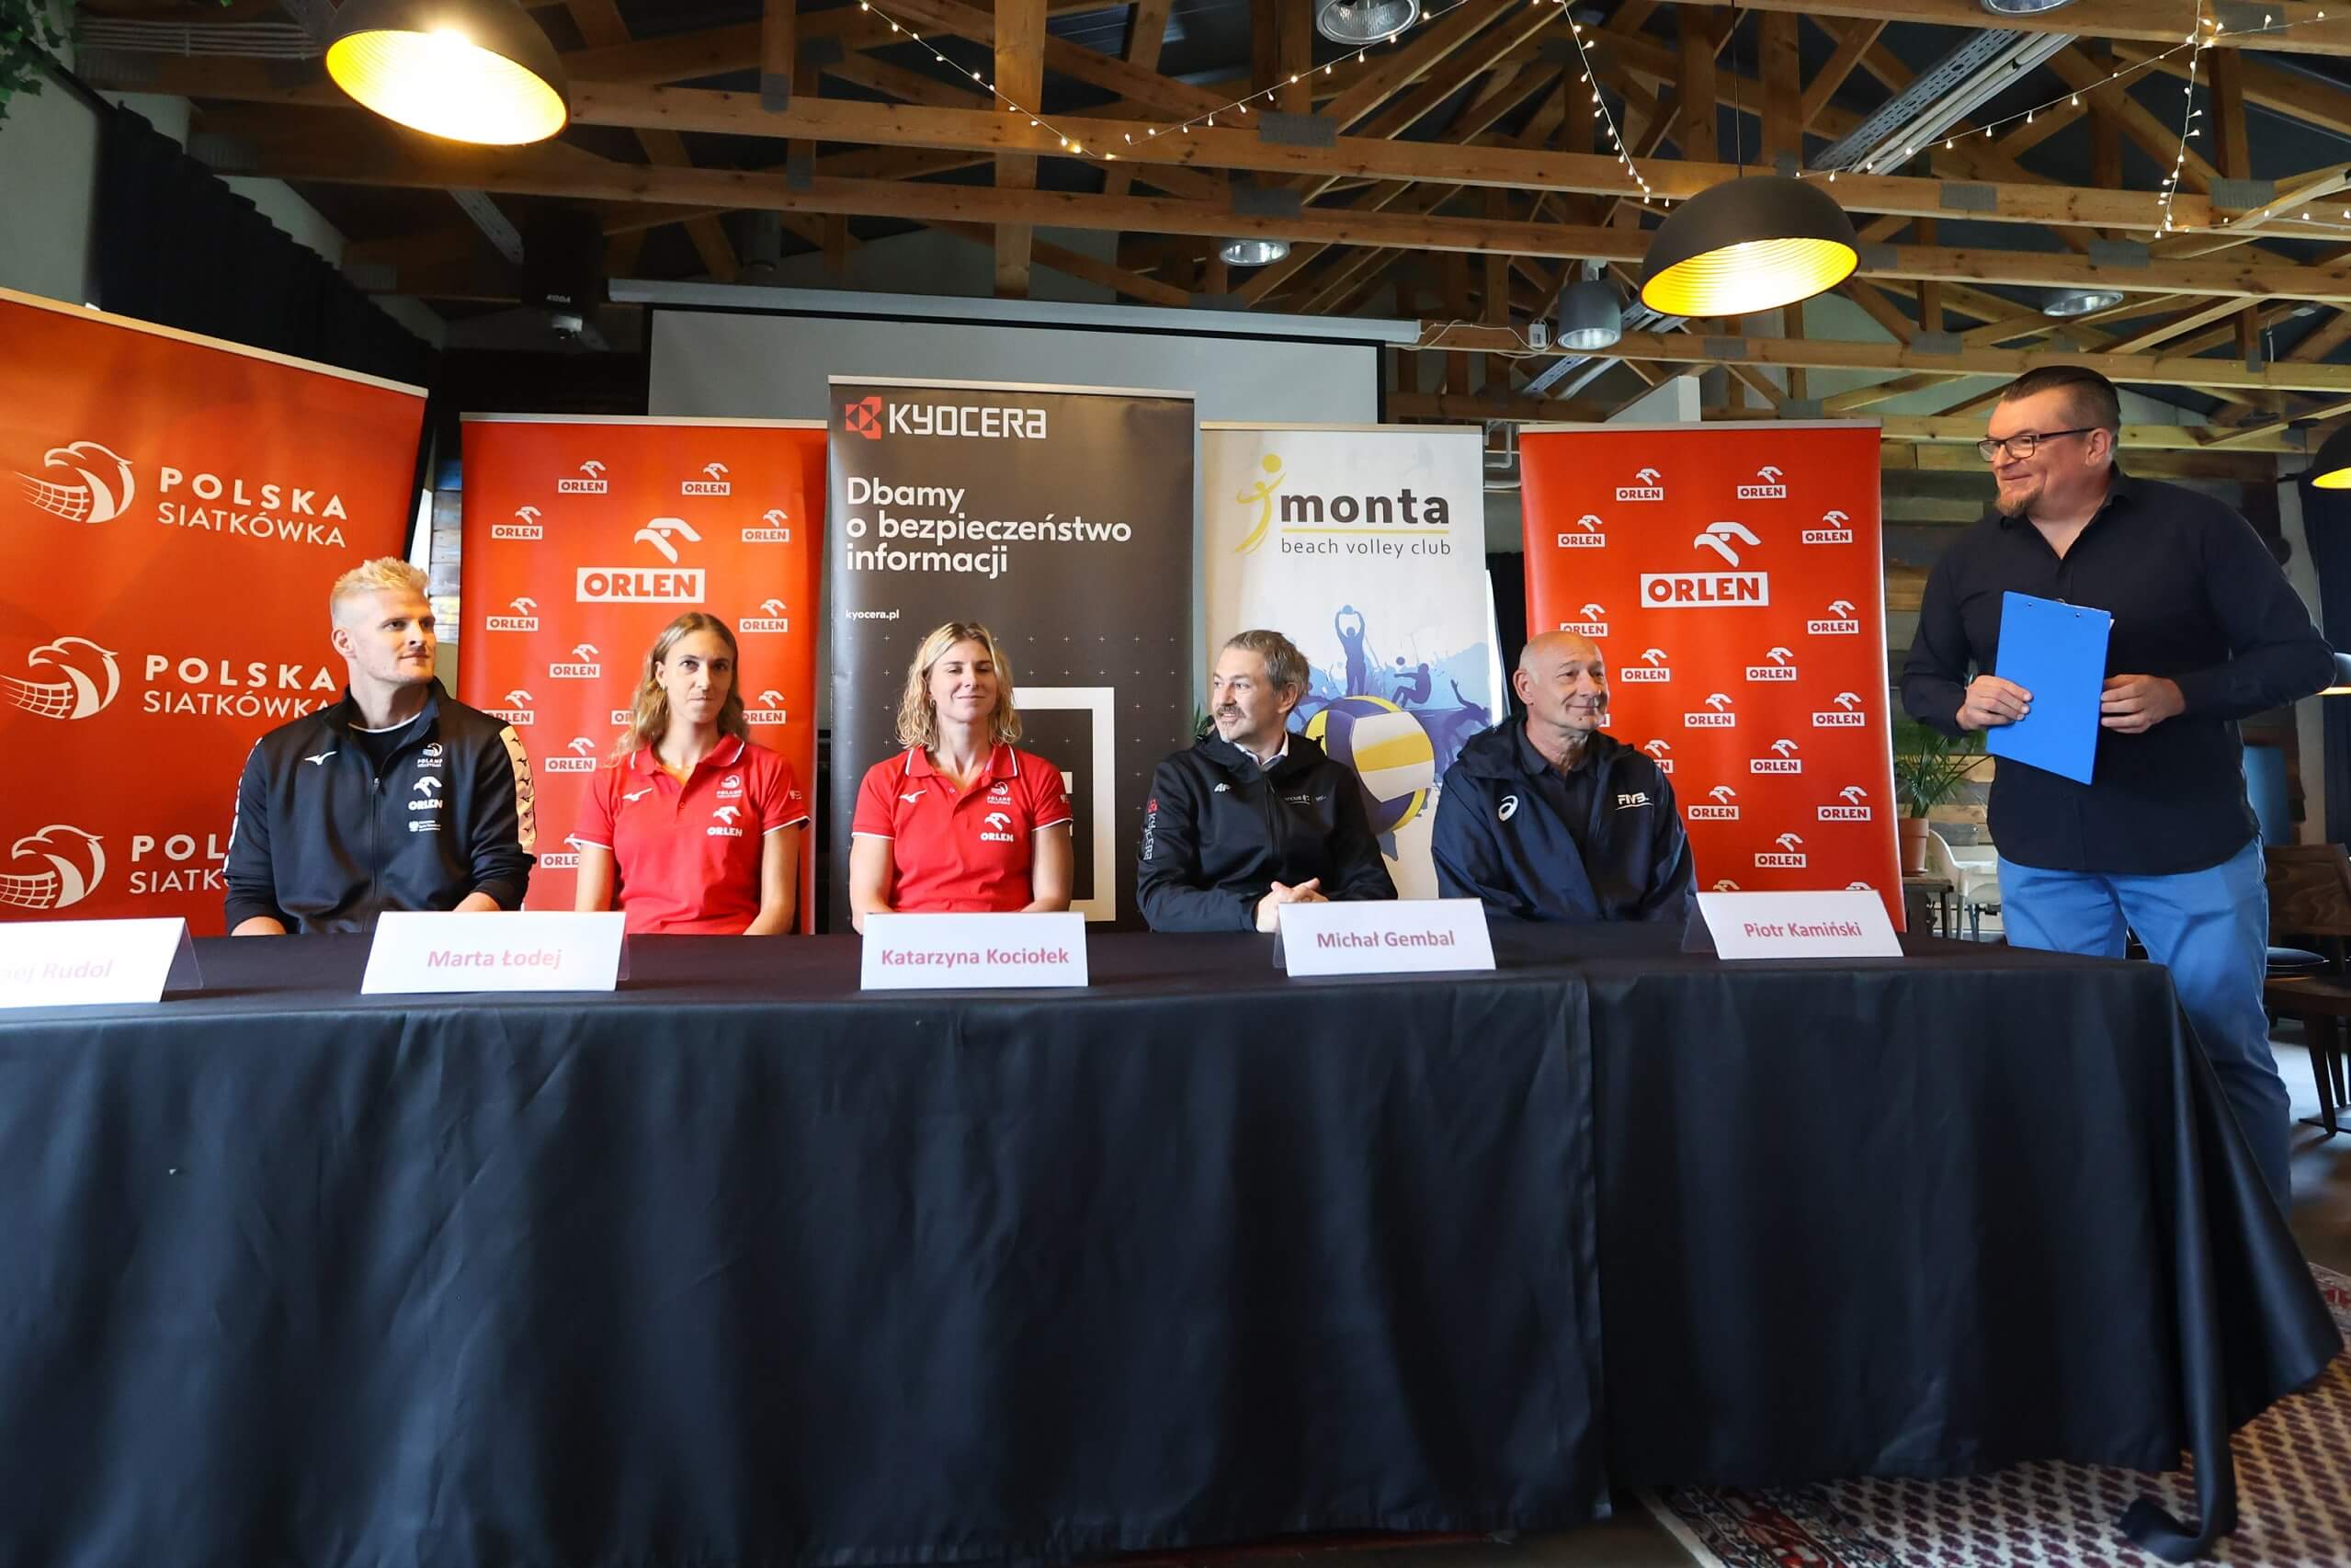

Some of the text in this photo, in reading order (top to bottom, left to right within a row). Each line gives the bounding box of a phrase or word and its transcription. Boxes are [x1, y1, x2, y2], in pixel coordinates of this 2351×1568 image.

[889, 403, 1047, 439] KYOCERA
[561, 482, 605, 492] ORLEN
[684, 483, 727, 494] ORLEN
[1740, 486, 1783, 498] ORLEN
[159, 466, 348, 521] POLSKA
[846, 477, 965, 514] Dbamy
[1618, 488, 1661, 499] ORLEN
[1280, 488, 1449, 525] monta
[157, 502, 346, 548] SIATKÓWKA
[846, 510, 1132, 547] o bezpieczeństwo
[494, 527, 539, 538] ORLEN
[744, 529, 786, 540] ORLEN
[1805, 530, 1850, 541] ORLEN
[1561, 535, 1602, 546] ORLEN
[1281, 538, 1451, 559] beach volley club
[846, 543, 1007, 579] informacji
[584, 572, 697, 597] ORLEN
[1648, 577, 1759, 602] ORLEN
[846, 608, 899, 621] kyocera.pl
[490, 619, 536, 629] ORLEN
[742, 619, 785, 631] ORLEN
[1563, 625, 1605, 634] ORLEN
[1810, 621, 1856, 632] ORLEN
[145, 653, 336, 692] POLSKA
[552, 665, 596, 676] ORLEN
[1624, 669, 1666, 680] ORLEN
[1749, 668, 1793, 679] ORLEN
[1687, 714, 1732, 725] ORLEN
[1815, 713, 1861, 725] ORLEN
[549, 759, 593, 770] ORLEN
[1754, 761, 1798, 772] ORLEN
[1617, 791, 1646, 805] FIVB
[408, 799, 444, 811] ORLEN
[1692, 807, 1736, 818] ORLEN
[1821, 808, 1868, 819] ORLEN
[707, 826, 743, 837] ORLEN
[980, 832, 1014, 843] ORLEN
[131, 833, 225, 862] POL
[543, 856, 578, 866] ORLE
[1758, 855, 1802, 866] ORLEN
[129, 869, 230, 894] SIATK
[1743, 921, 1862, 938] Piotr Kamiński
[1317, 929, 1455, 949] Michał Gembal
[427, 949, 562, 971] Marta Łodej
[881, 947, 1069, 969] Katarzyna Kociołek
[42, 959, 114, 980] Rudol
